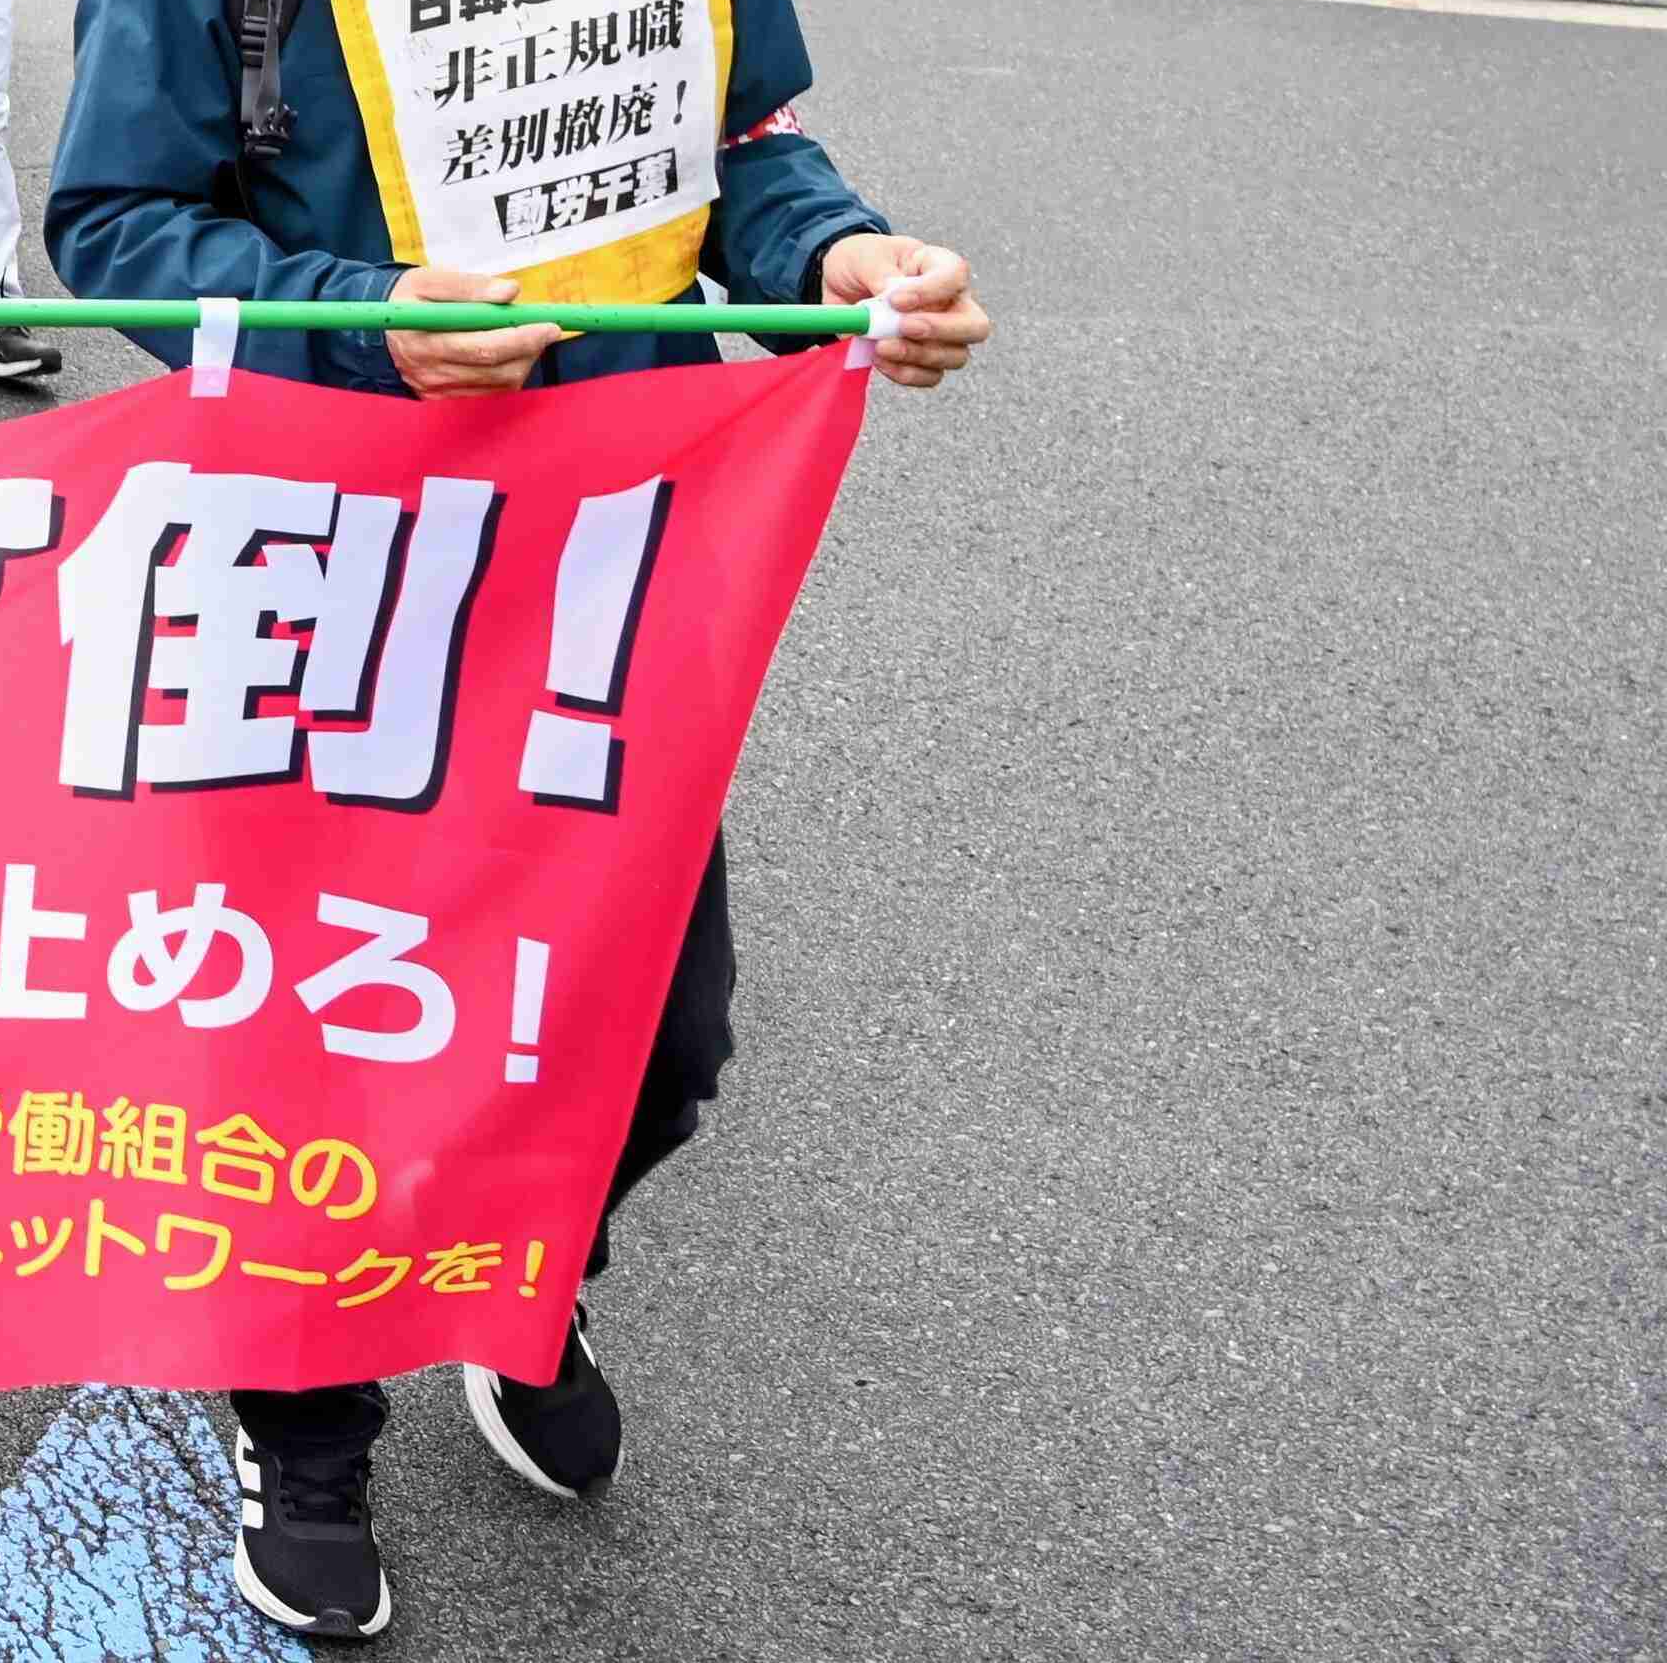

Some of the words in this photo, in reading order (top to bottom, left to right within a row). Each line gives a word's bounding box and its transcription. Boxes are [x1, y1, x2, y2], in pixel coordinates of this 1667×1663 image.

[440, 79, 688, 186] 差別撤廃！
[503, 150, 677, 240] 動労千葉
